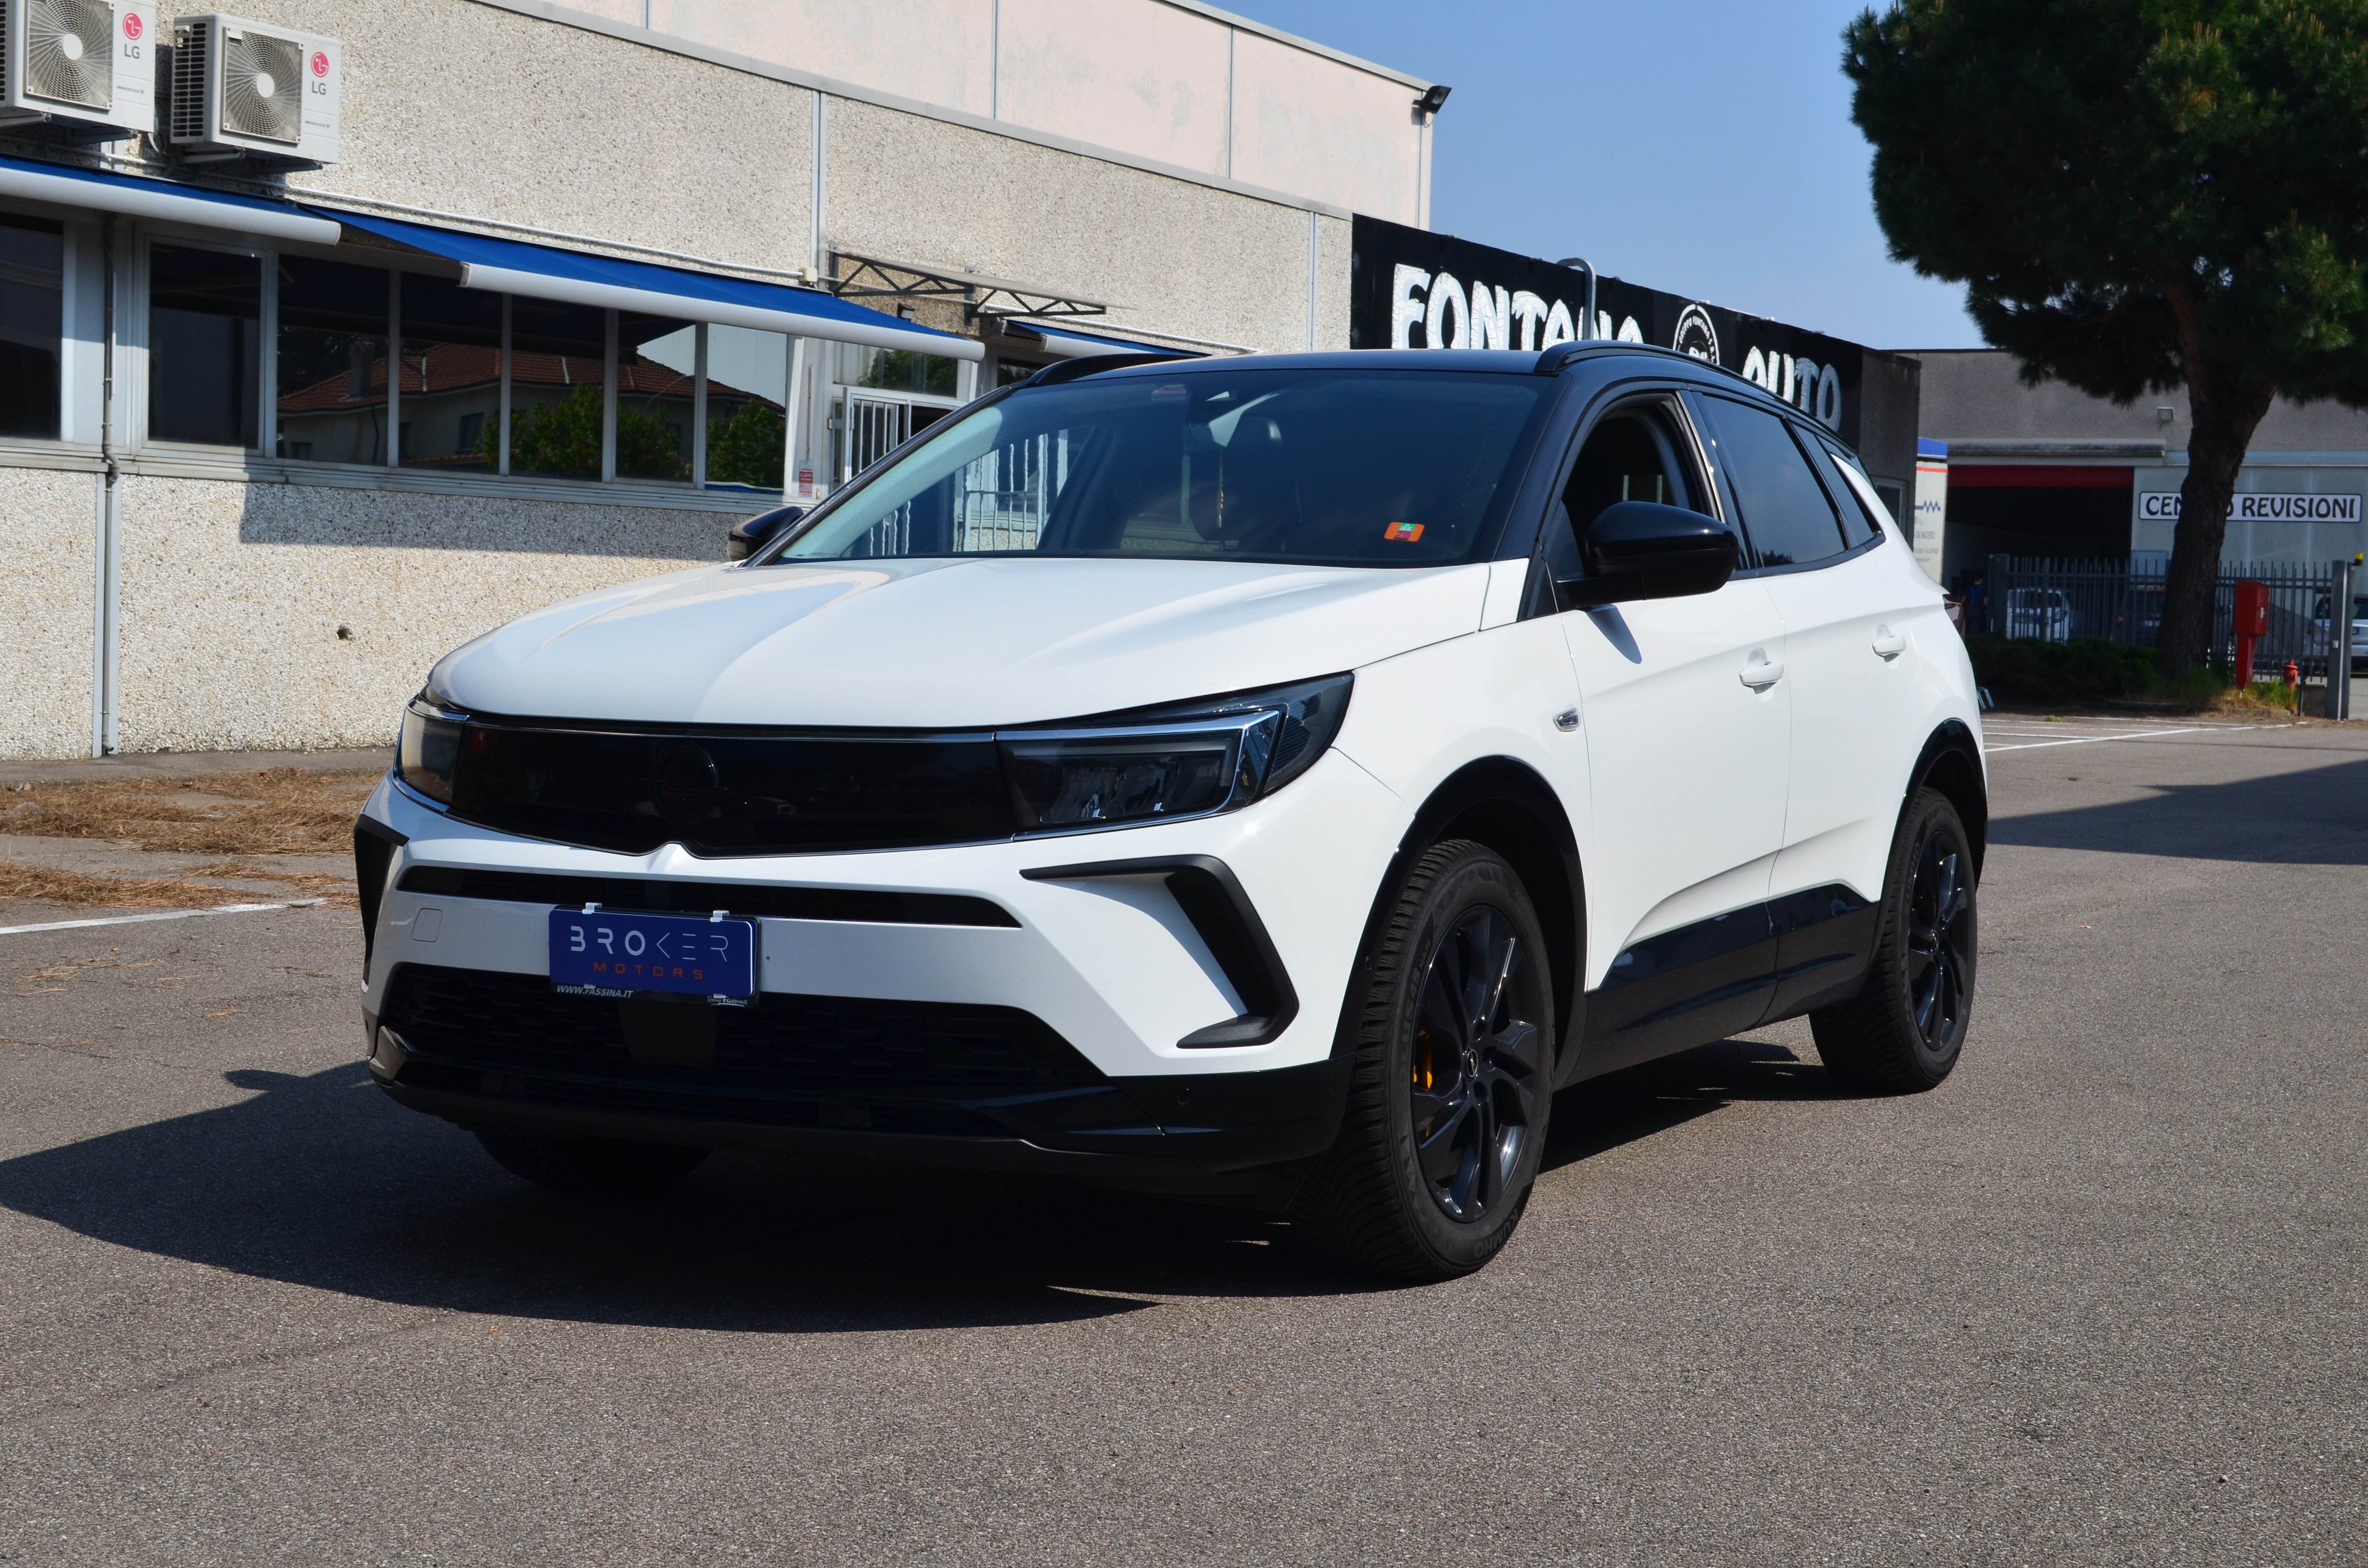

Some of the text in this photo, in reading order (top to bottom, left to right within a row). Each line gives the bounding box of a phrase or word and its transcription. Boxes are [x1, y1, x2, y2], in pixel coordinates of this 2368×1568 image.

[124, 43, 140, 59] LG
[116, 85, 140, 94] INVERTER
[311, 81, 326, 95] LG
[2242, 497, 2355, 519] REVISIONI
[570, 925, 728, 962] BROKER
[593, 962, 703, 980] MOTORS
[557, 984, 634, 998] WWW.FASSINA.IT
